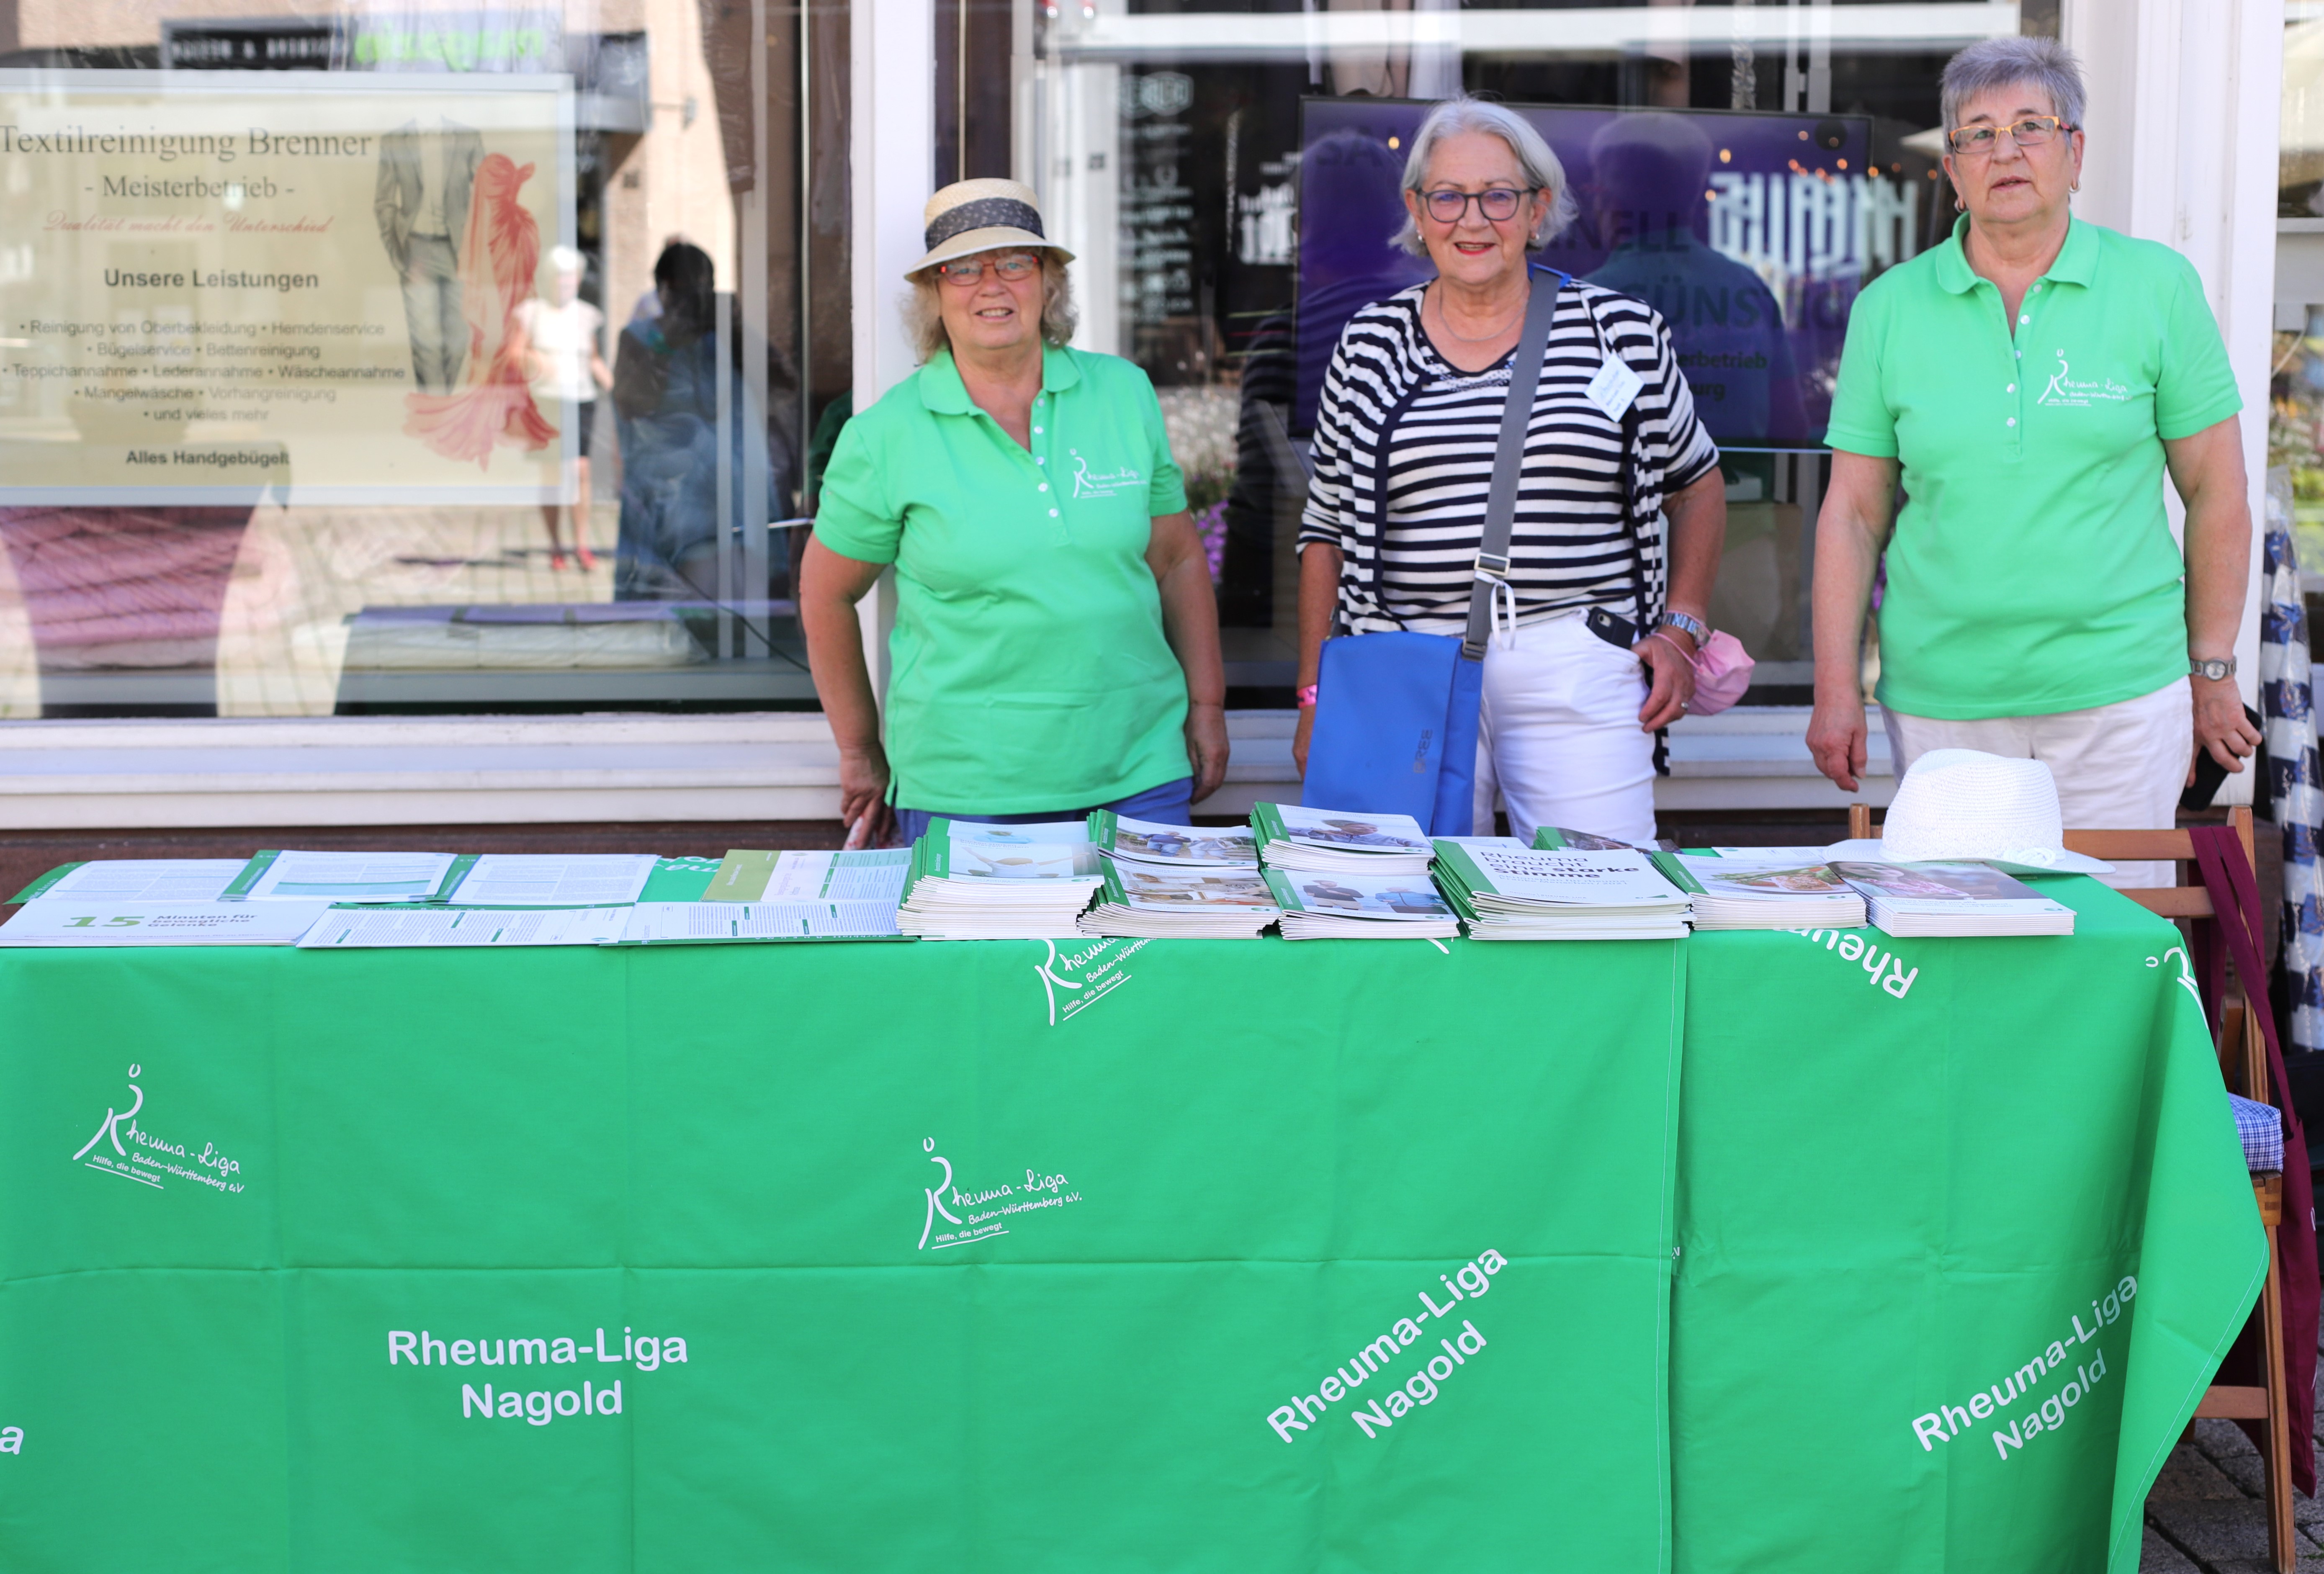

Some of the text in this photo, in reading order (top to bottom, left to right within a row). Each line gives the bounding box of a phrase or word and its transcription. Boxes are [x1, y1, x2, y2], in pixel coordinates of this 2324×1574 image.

[0, 126, 372, 162] Textilreinigung Brenner
[103, 175, 278, 198] Meisterbetrieb
[43, 210, 124, 232] Qualität
[105, 269, 319, 292] Unsere Leistungen
[31, 320, 384, 335] Reinigung von Oberbekleidung Hemdenservice
[98, 343, 320, 359] Bügelservice Bettenreinigung
[1677, 351, 1767, 369] erbetrieb
[13, 363, 405, 380] Teppichannahme Lederannahme Wäscheannahme
[84, 386, 336, 403] Mangelwäsche Vorhangreinigung
[154, 408, 269, 421] und vieles mehr
[126, 450, 290, 468] Alles Handgebügelt
[1480, 851, 1588, 862] Rheuma
[1485, 857, 1587, 867] braucht
[1494, 868, 1601, 878] Stimme
[62, 916, 145, 928] 15
[1086, 938, 1157, 982] Baden-Württem
[1062, 969, 1124, 1013] Hilfe, die bewegt
[93, 1154, 161, 1183] Hilfe, die bewegt
[132, 1152, 226, 1192] Baden-Württemberg
[968, 1191, 1082, 1225] Baden-Württemberg e.V.
[935, 1222, 1003, 1243] Hilfe, die bewegt
[388, 1326, 688, 1371] Rheuma-Liga
[1266, 1248, 1508, 1443] Rheuma-Liga
[1912, 1276, 2137, 1452] Rheuma-Liga
[1351, 1319, 1487, 1439] Nagold
[462, 1379, 622, 1426] Nagold
[1992, 1348, 2107, 1461] Nagold
